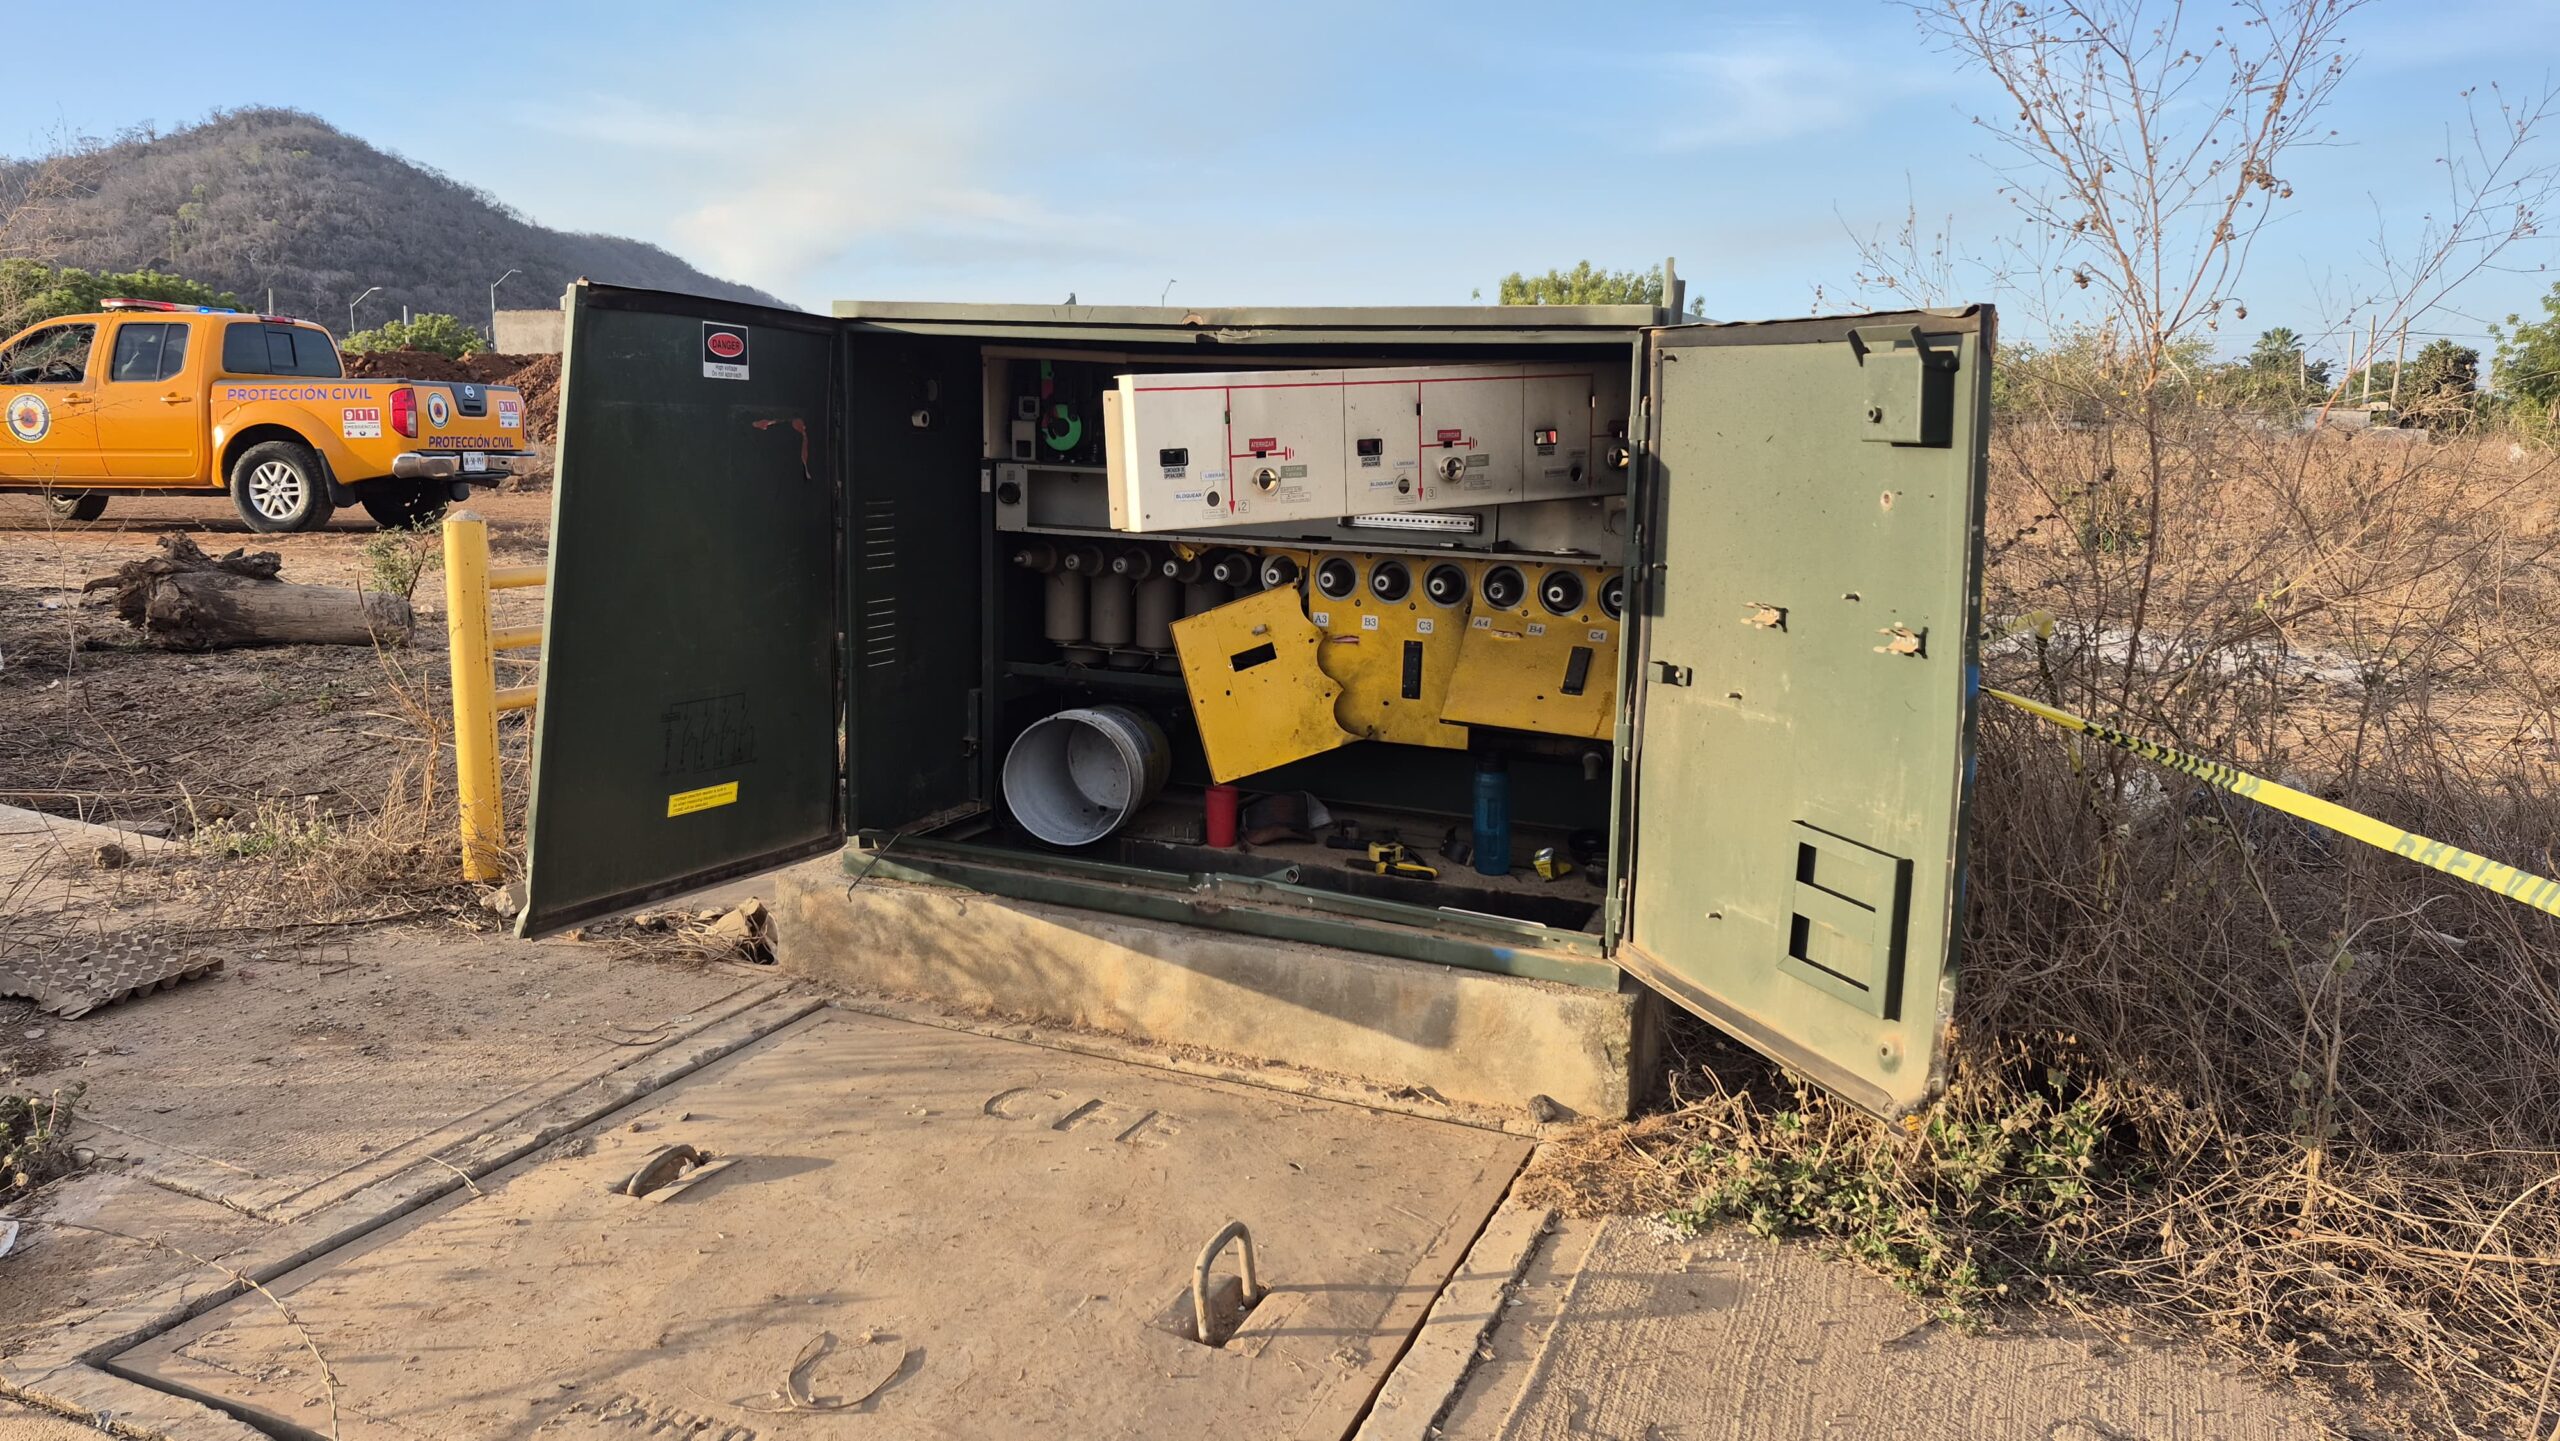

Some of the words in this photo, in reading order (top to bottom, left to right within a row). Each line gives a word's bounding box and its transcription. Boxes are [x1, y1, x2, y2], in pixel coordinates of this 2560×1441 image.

[712, 339, 740, 350] DANGER
[227, 385, 327, 400] PROTECCIÓN
[332, 387, 372, 400] CIVIL
[344, 409, 378, 421] 911
[429, 434, 490, 448] PROTECCIÓN
[492, 436, 513, 448] CIVIL
[1428, 488, 1434, 498] 3
[1241, 501, 1247, 511] 2
[1314, 615, 1328, 624] A3
[1364, 617, 1377, 627] B3
[1474, 619, 1488, 627] A4
[1418, 621, 1431, 631] C3
[1529, 625, 1542, 633] B4
[1590, 631, 1604, 640] C4
[983, 1086, 1199, 1148] CFE
